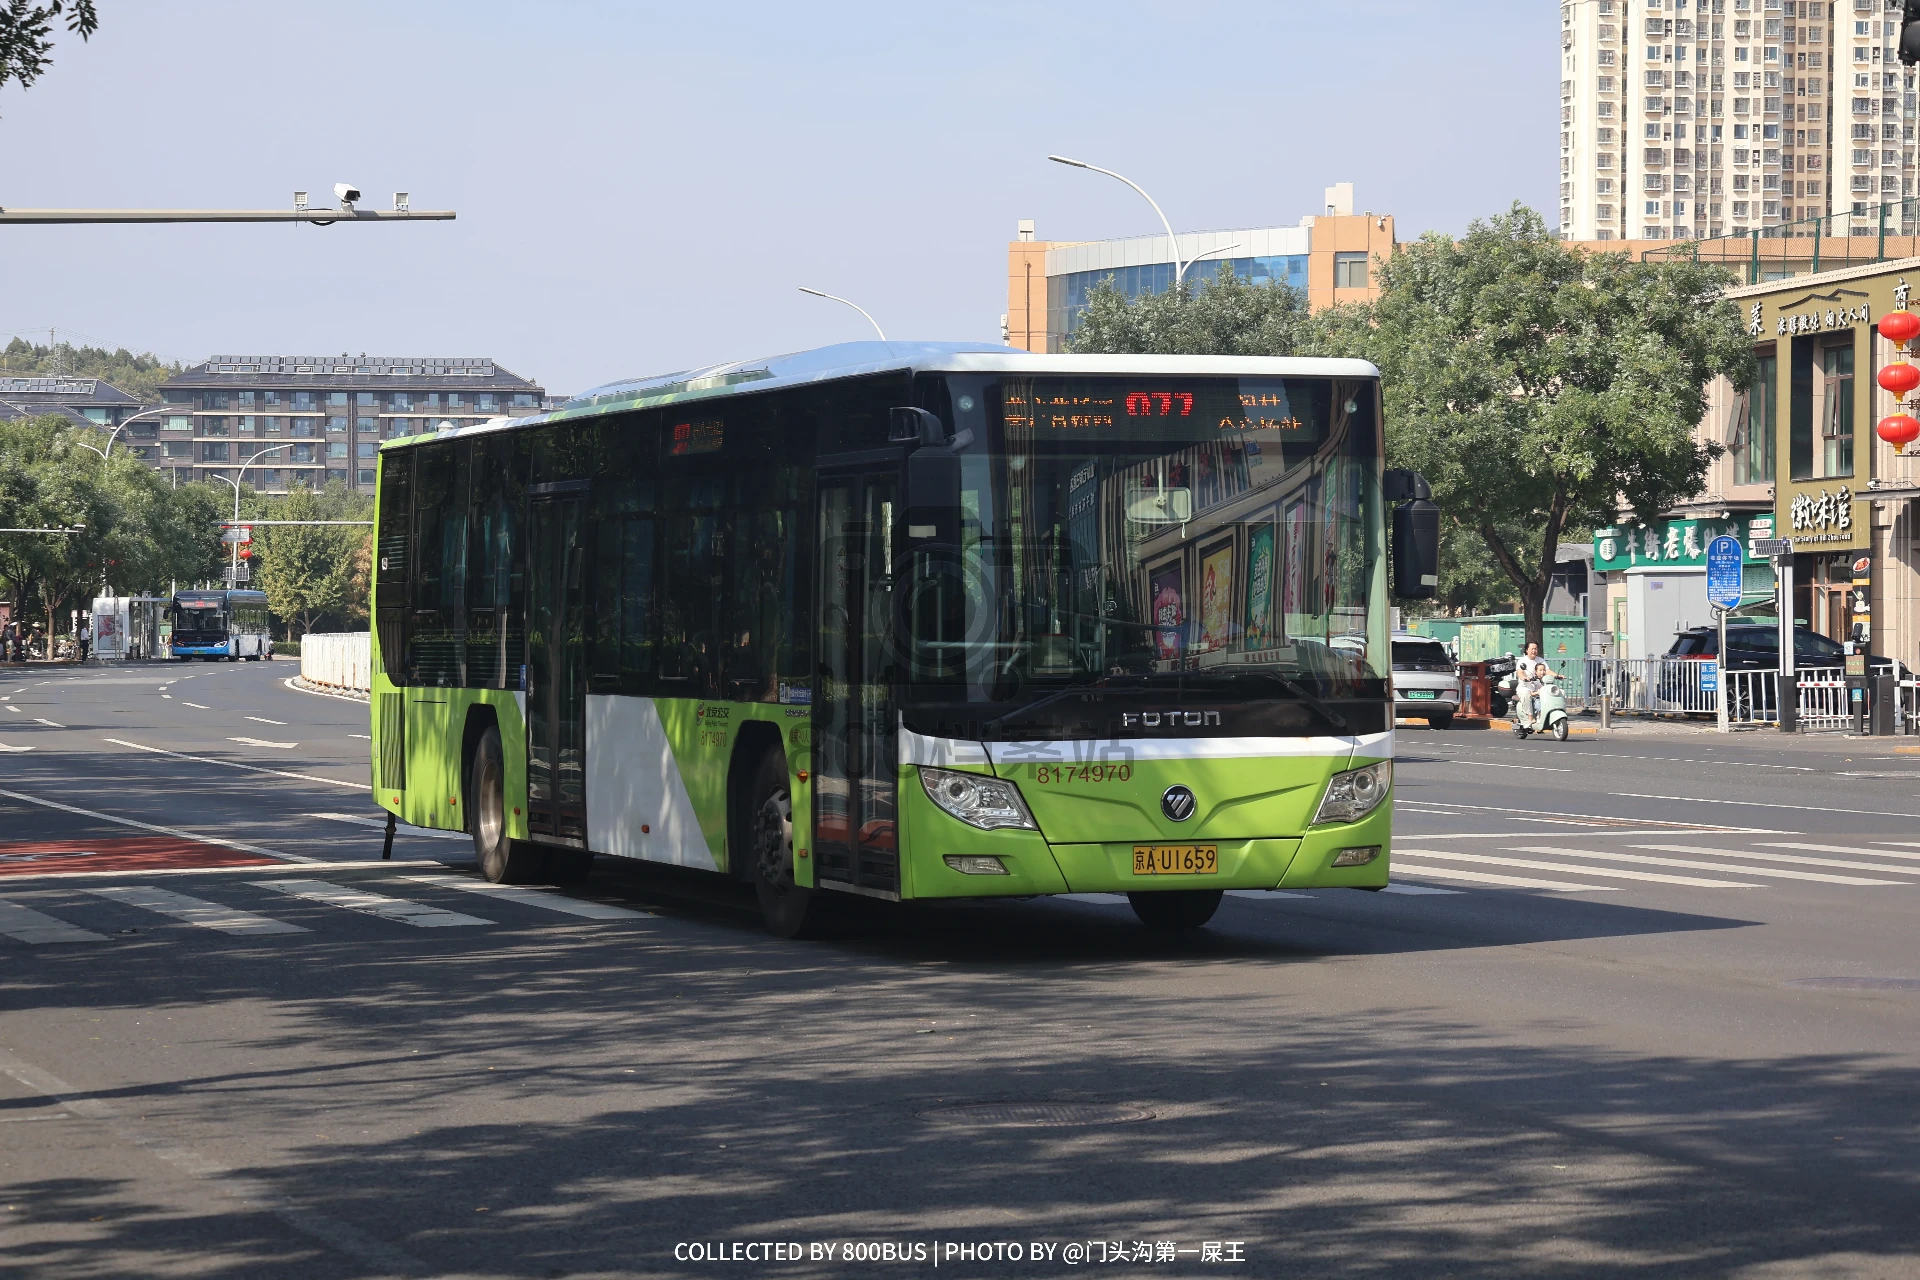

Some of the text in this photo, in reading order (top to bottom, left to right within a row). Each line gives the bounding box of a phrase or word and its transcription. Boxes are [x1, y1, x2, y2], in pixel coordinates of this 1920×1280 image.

[1749, 301, 1764, 336] 菜
[1790, 485, 1850, 530] 徽味馆
[1720, 542, 1729, 552] P
[706, 706, 730, 719] 北京公交
[1123, 711, 1221, 726] FOTON
[700, 730, 727, 748] 8174970
[1037, 764, 1131, 784] 8174970
